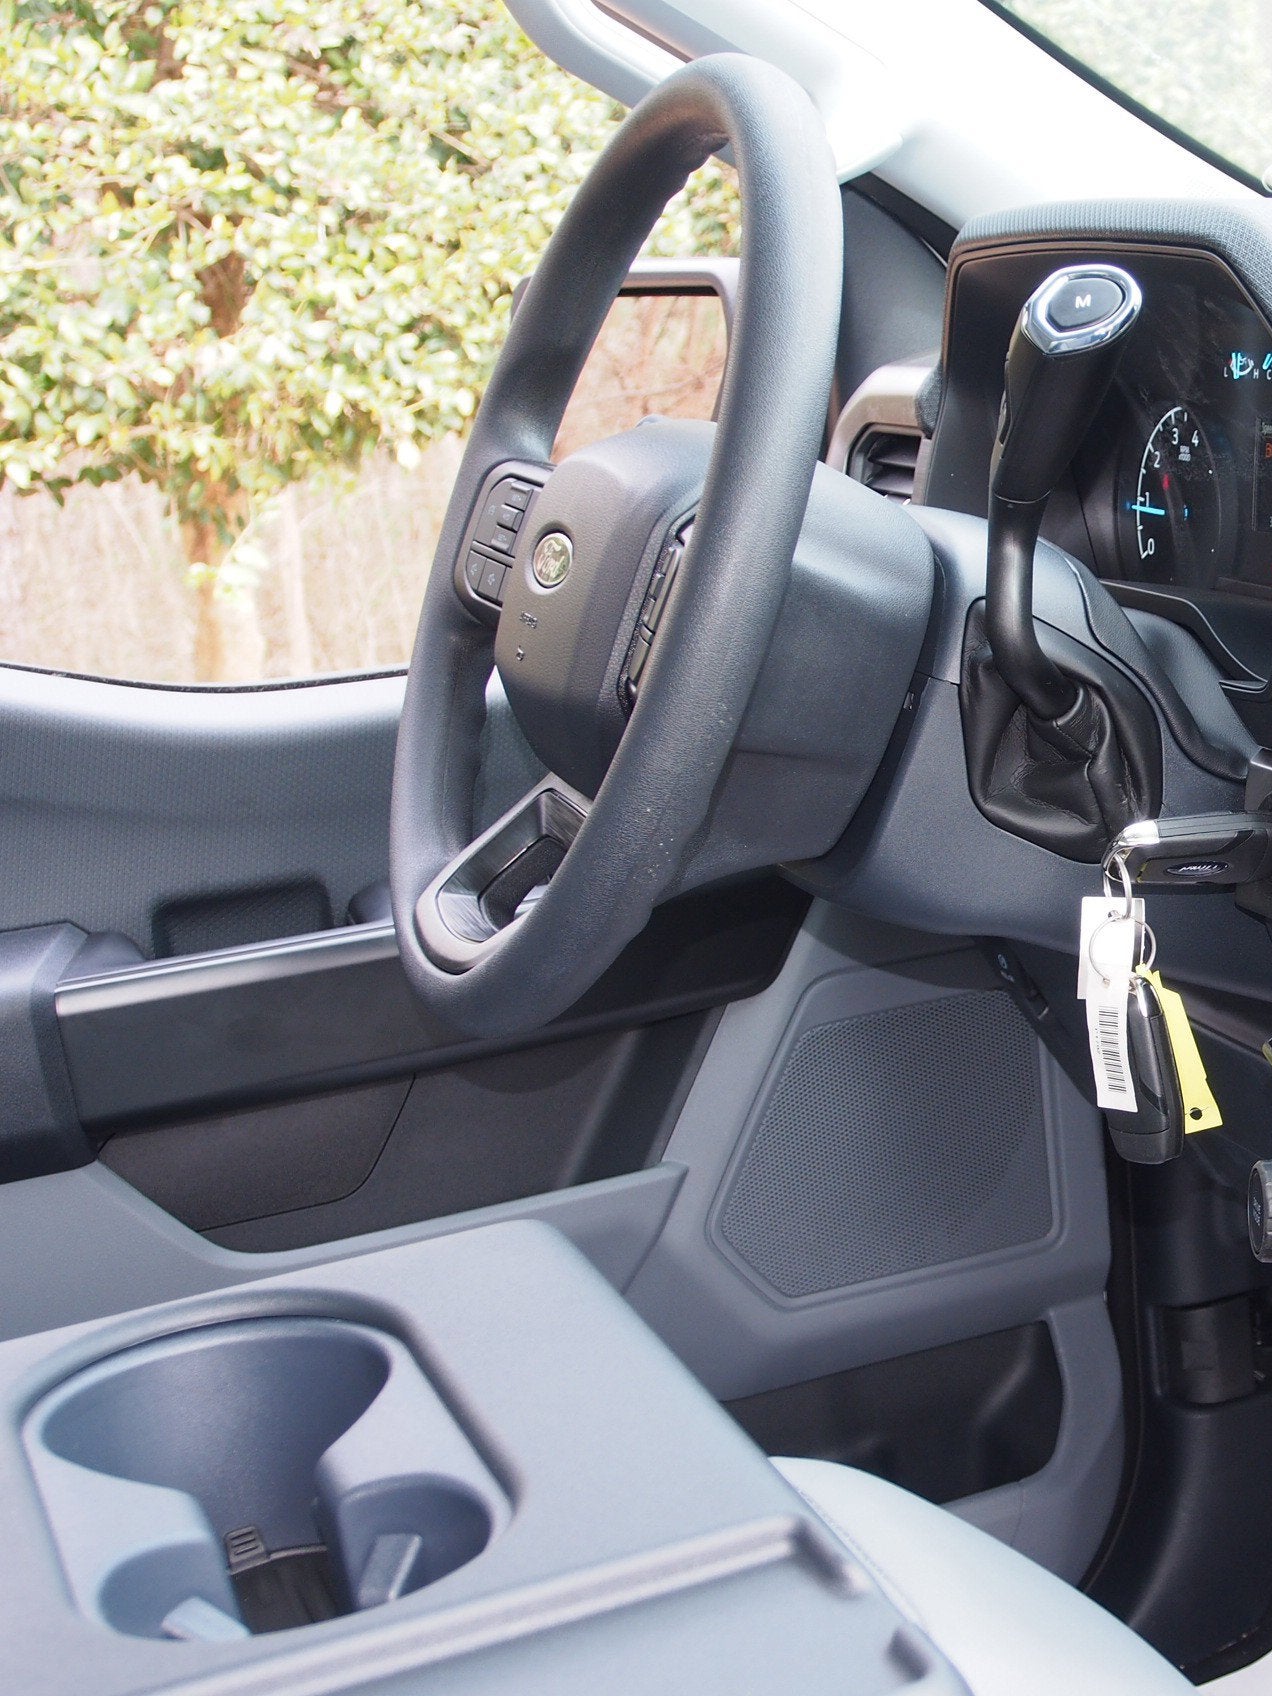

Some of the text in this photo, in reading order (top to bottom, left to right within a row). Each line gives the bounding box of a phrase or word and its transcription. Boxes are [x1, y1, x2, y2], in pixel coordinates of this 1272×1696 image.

[1074, 293, 1092, 309] M
[1253, 368, 1260, 379] H
[1266, 369, 1272, 380] C
[1171, 427, 1179, 445] 3
[1191, 429, 1200, 447] 4
[1153, 451, 1161, 468] 2
[1145, 491, 1151, 507] 1
[1148, 537, 1155, 555] 0
